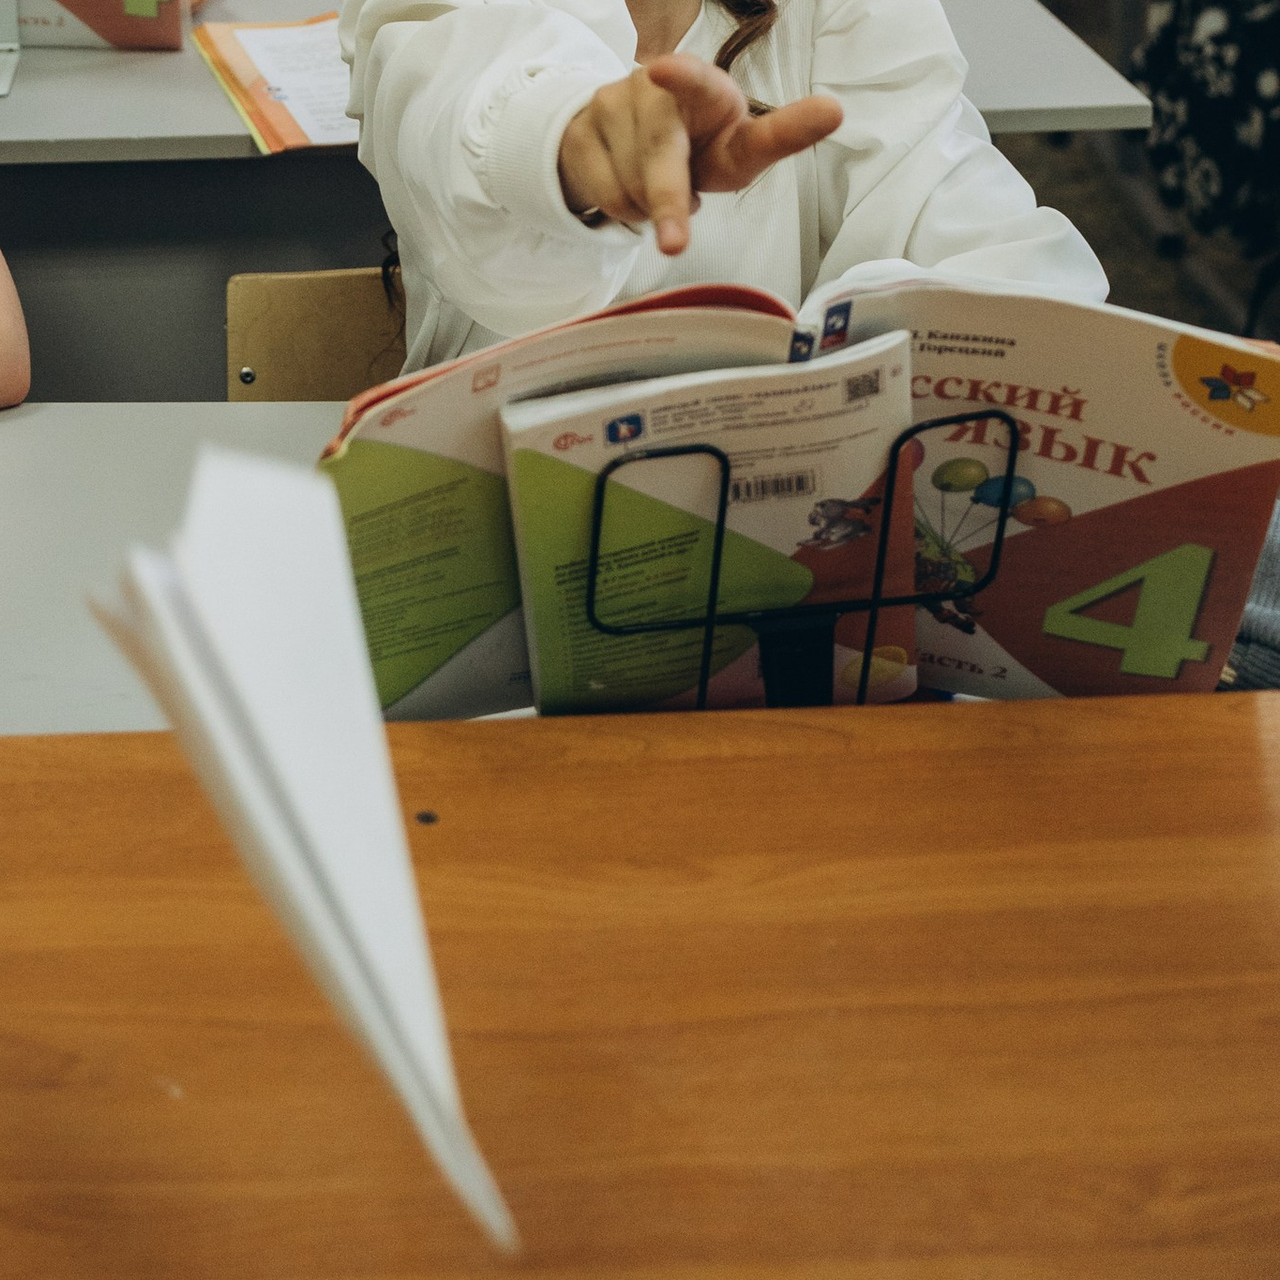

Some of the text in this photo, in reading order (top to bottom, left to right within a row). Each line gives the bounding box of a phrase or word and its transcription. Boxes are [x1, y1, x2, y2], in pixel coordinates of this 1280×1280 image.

[910, 374, 1089, 422] сский
[1042, 542, 1216, 679] 4
[920, 649, 1008, 681] асть 2
